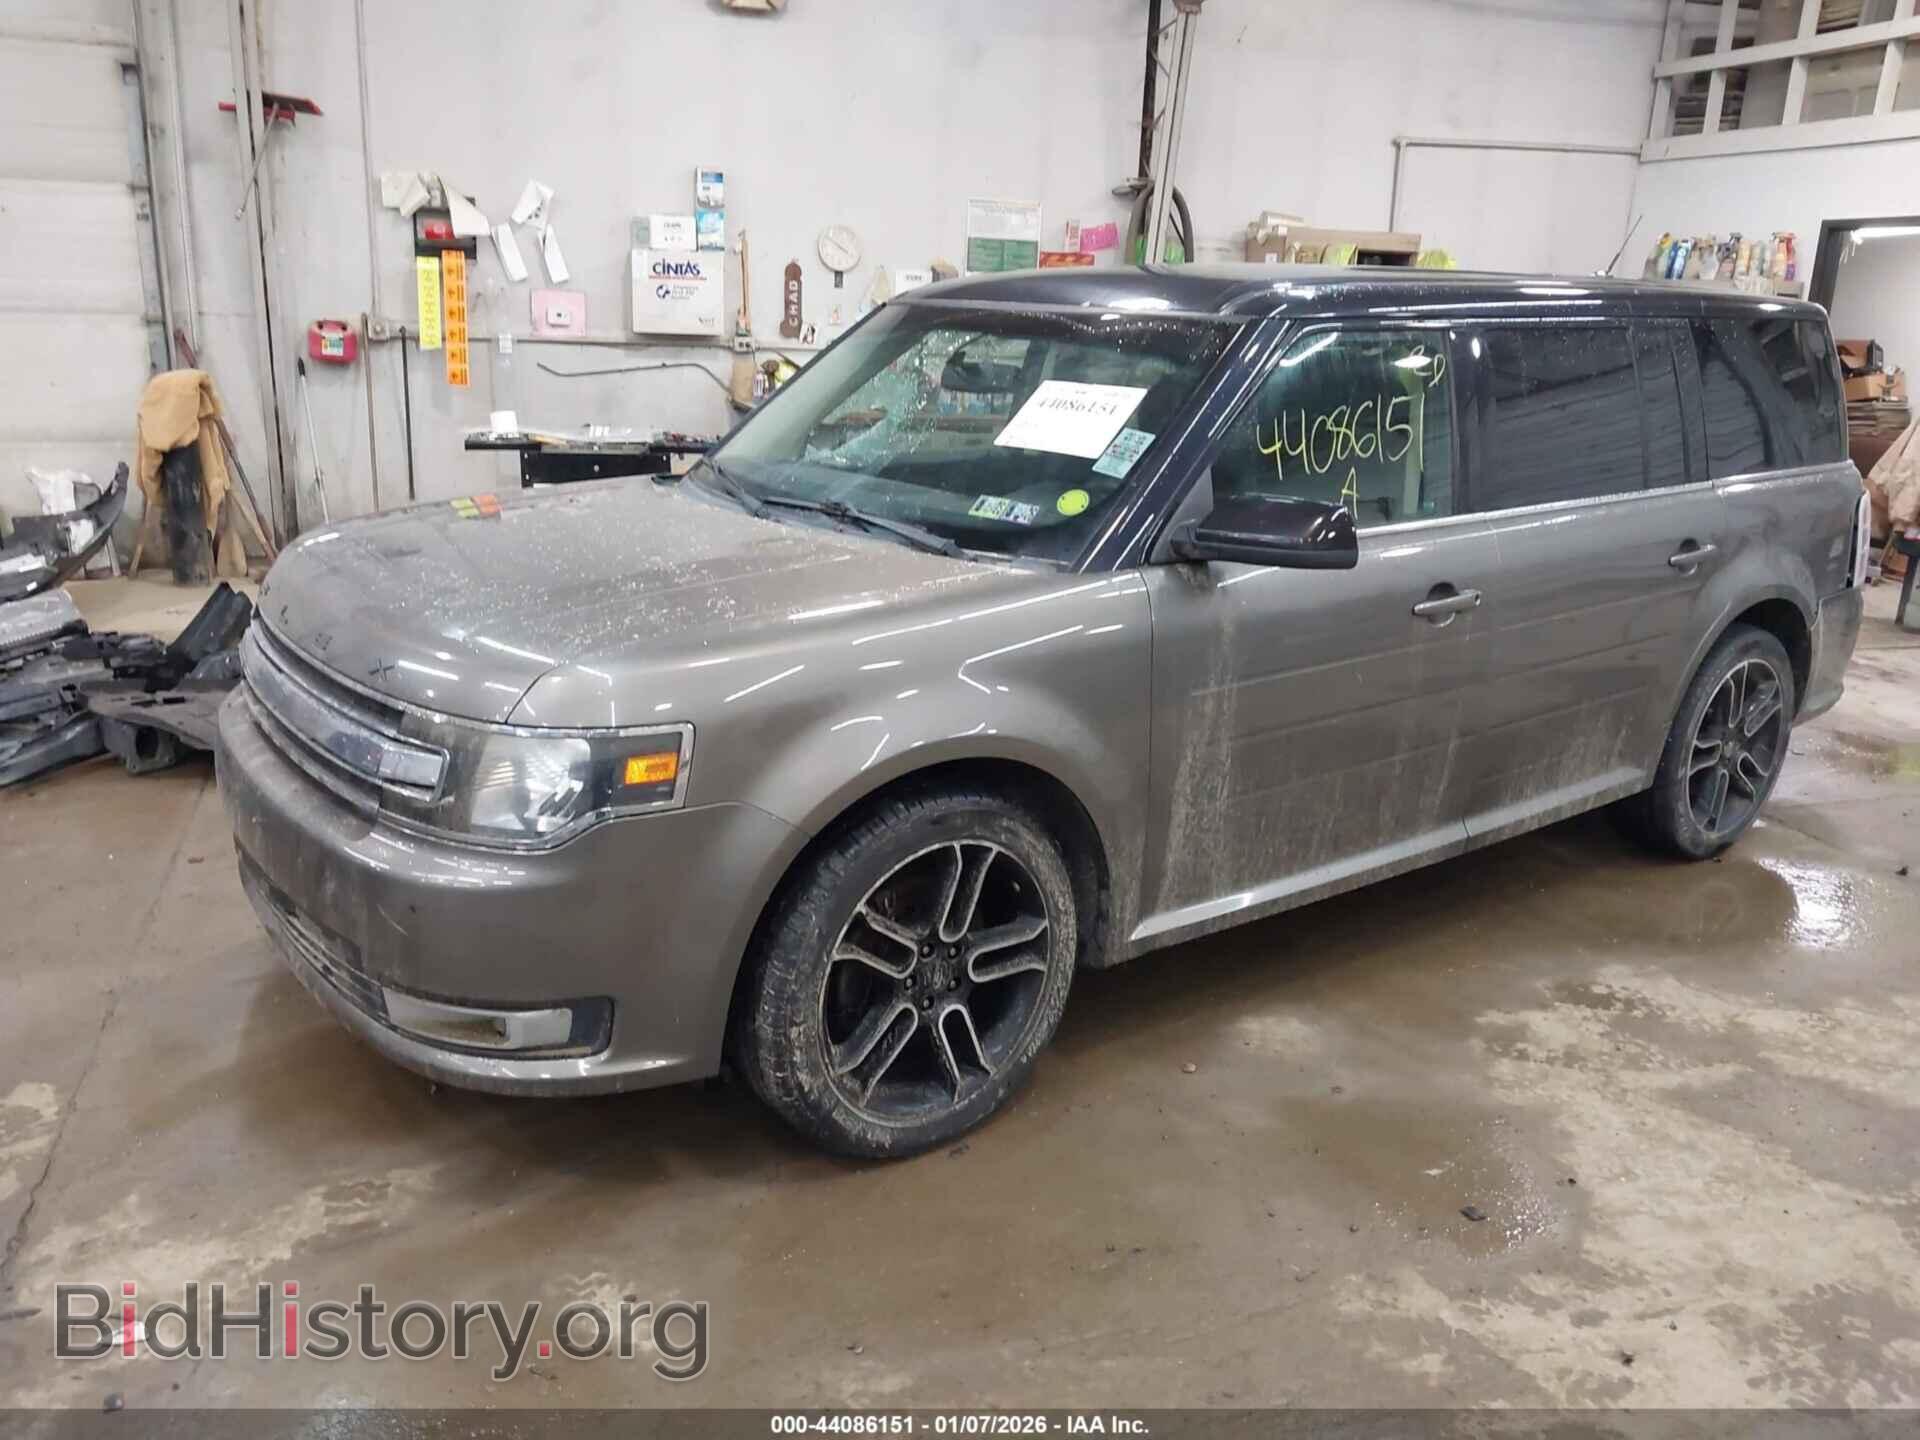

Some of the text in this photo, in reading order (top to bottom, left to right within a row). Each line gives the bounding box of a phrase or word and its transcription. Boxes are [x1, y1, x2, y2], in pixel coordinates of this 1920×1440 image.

[652, 258, 701, 276] CINTAS
[788, 279, 799, 328] CHAD
[1256, 392, 1426, 481] 44086151
